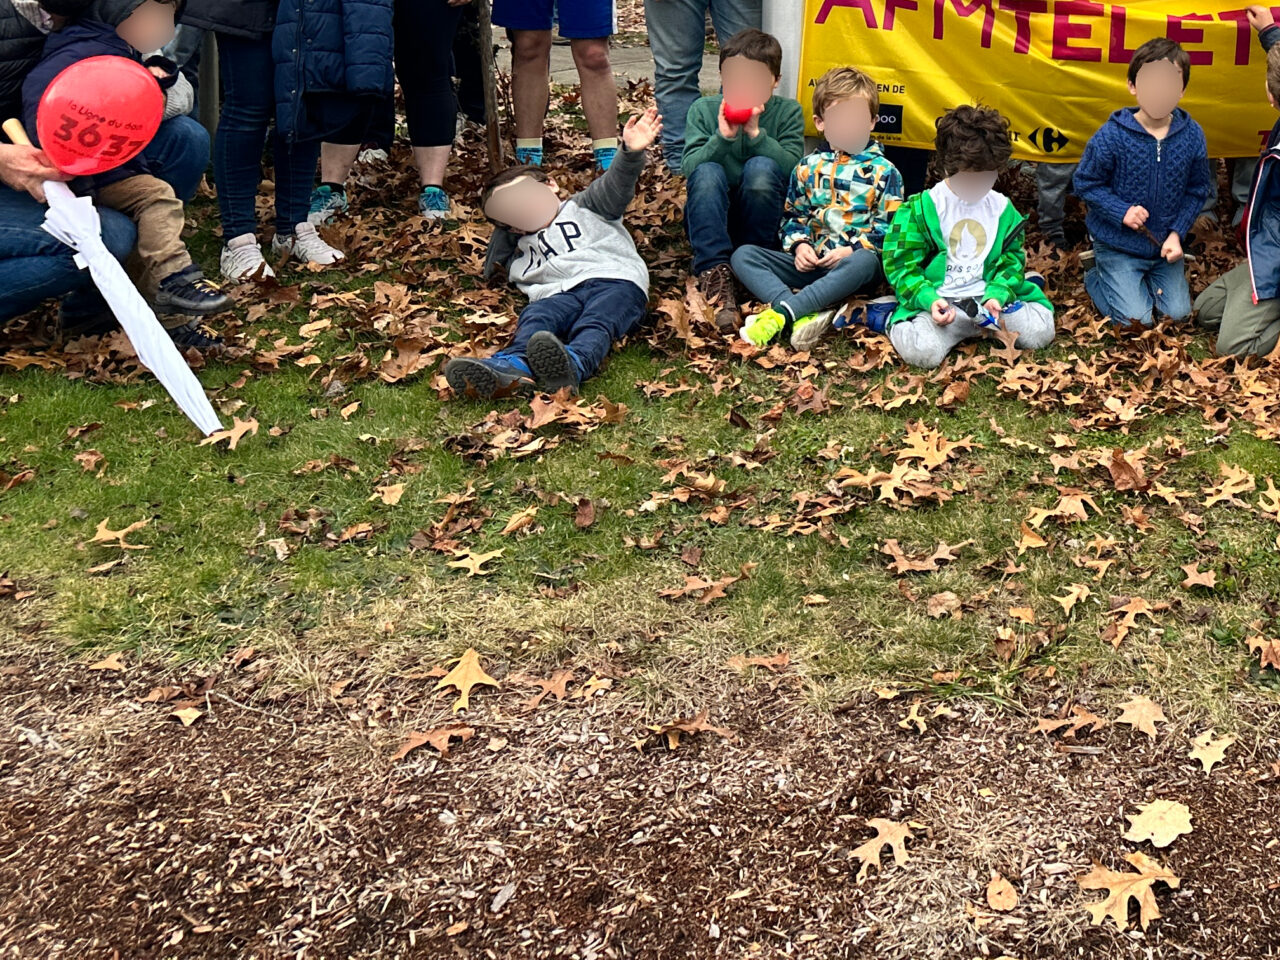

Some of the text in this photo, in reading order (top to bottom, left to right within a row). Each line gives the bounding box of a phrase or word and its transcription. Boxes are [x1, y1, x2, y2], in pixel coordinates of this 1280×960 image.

[892, 85, 905, 94] DE
[78, 105, 106, 123] Ligne
[108, 119, 122, 128] du
